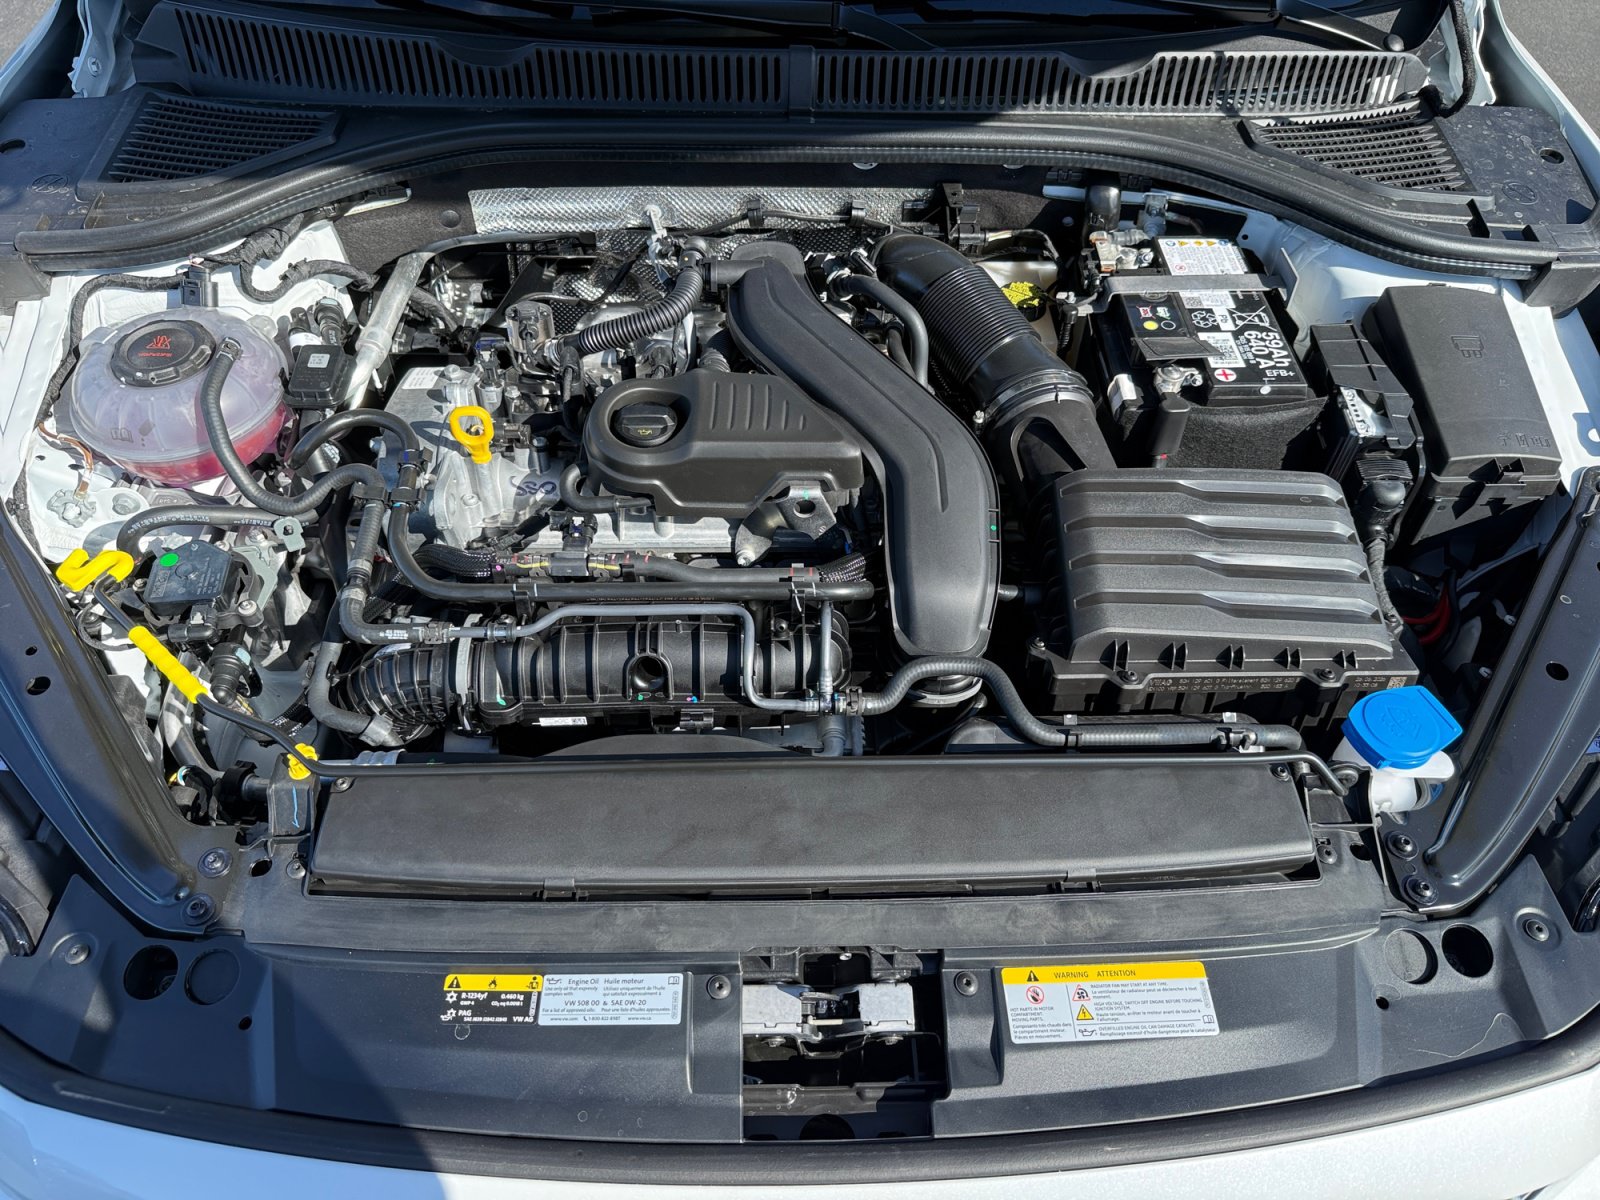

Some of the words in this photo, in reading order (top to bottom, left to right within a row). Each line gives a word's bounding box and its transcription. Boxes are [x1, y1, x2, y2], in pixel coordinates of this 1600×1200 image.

[1218, 314, 1229, 324] Pb
[1244, 330, 1269, 355] 640
[1262, 331, 1291, 367] 59Ah
[1265, 369, 1296, 377] EFB+
[1054, 970, 1089, 979] WARNING
[1096, 969, 1136, 978] ATTENTION
[568, 978, 589, 986] Engine
[461, 992, 488, 1001] R-1234yf
[517, 993, 525, 1001] kg
[458, 1009, 472, 1017] PAG
